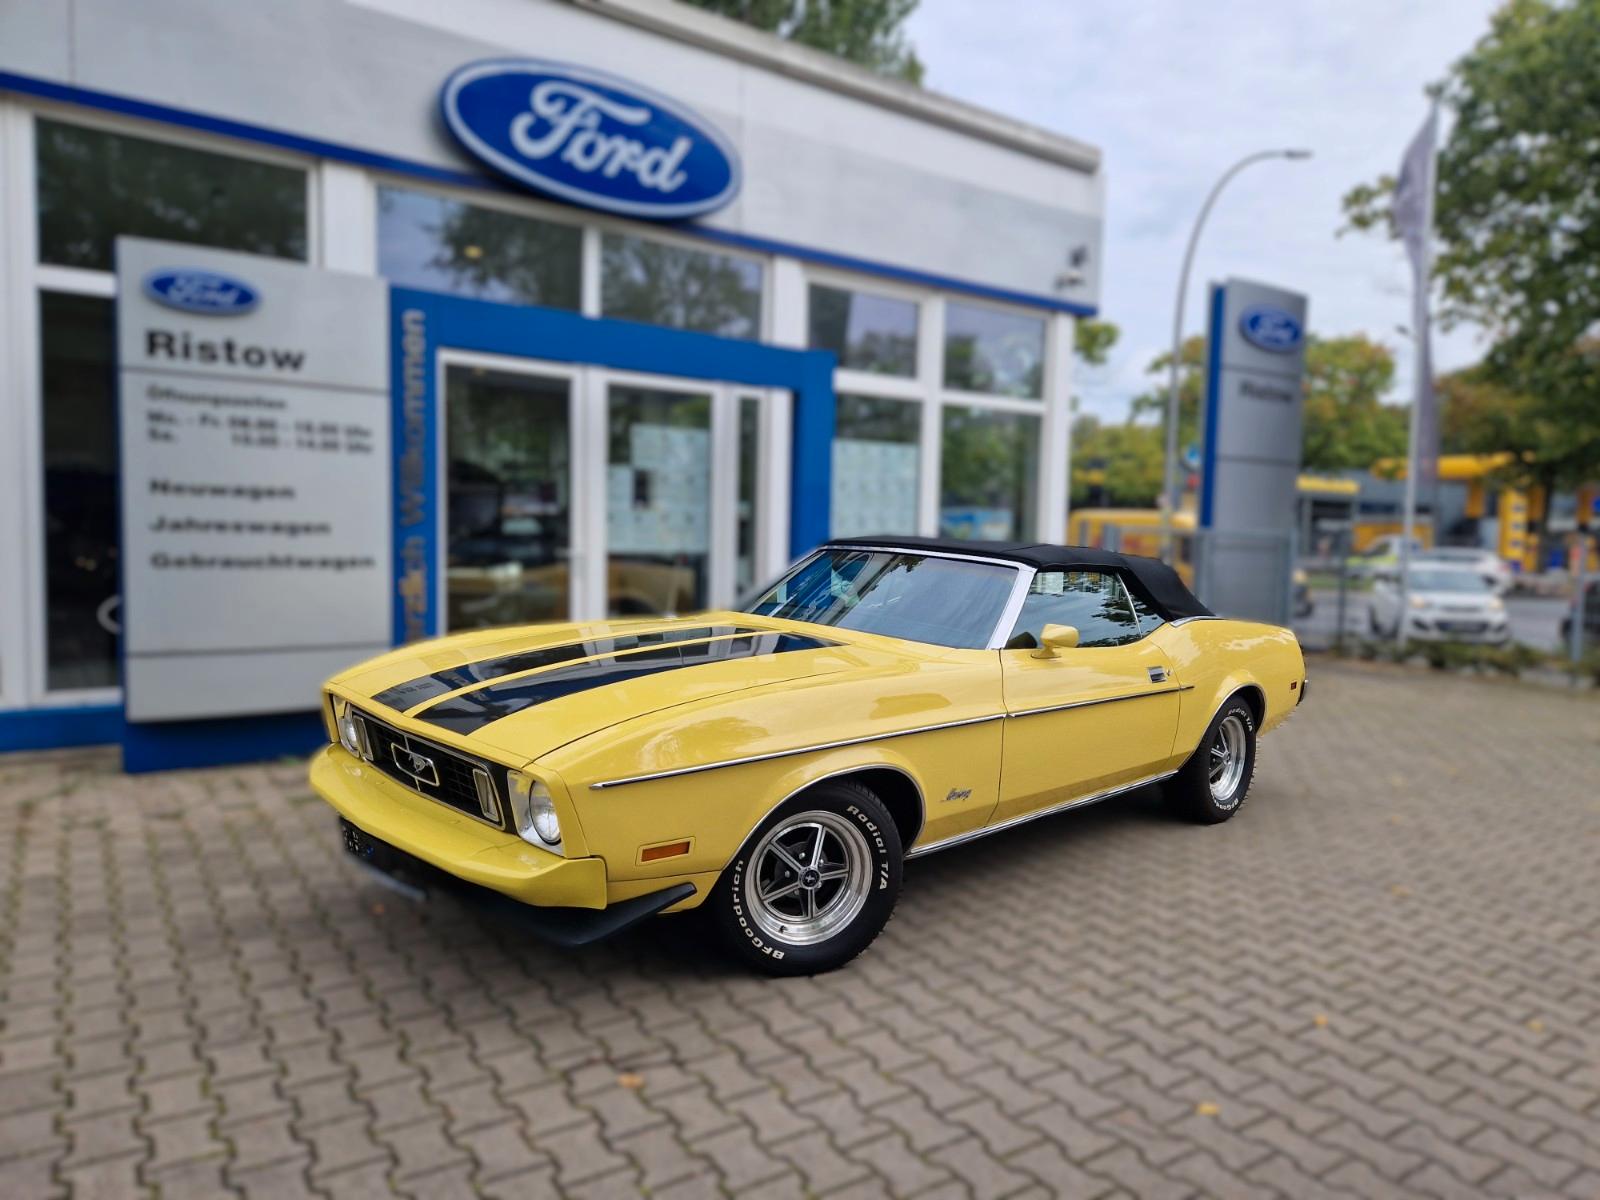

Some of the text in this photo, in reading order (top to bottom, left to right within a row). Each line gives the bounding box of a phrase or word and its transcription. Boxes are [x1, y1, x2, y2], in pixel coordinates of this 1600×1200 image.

[508, 79, 694, 193] Ford
[146, 330, 305, 371] Ristow
[150, 480, 295, 500] Neuwagen
[150, 516, 331, 537] Jahreswagen
[151, 553, 376, 571] Gebrauchtwagen
[846, 805, 889, 890] Radial T/A
[731, 860, 785, 960] BFGoodrich
